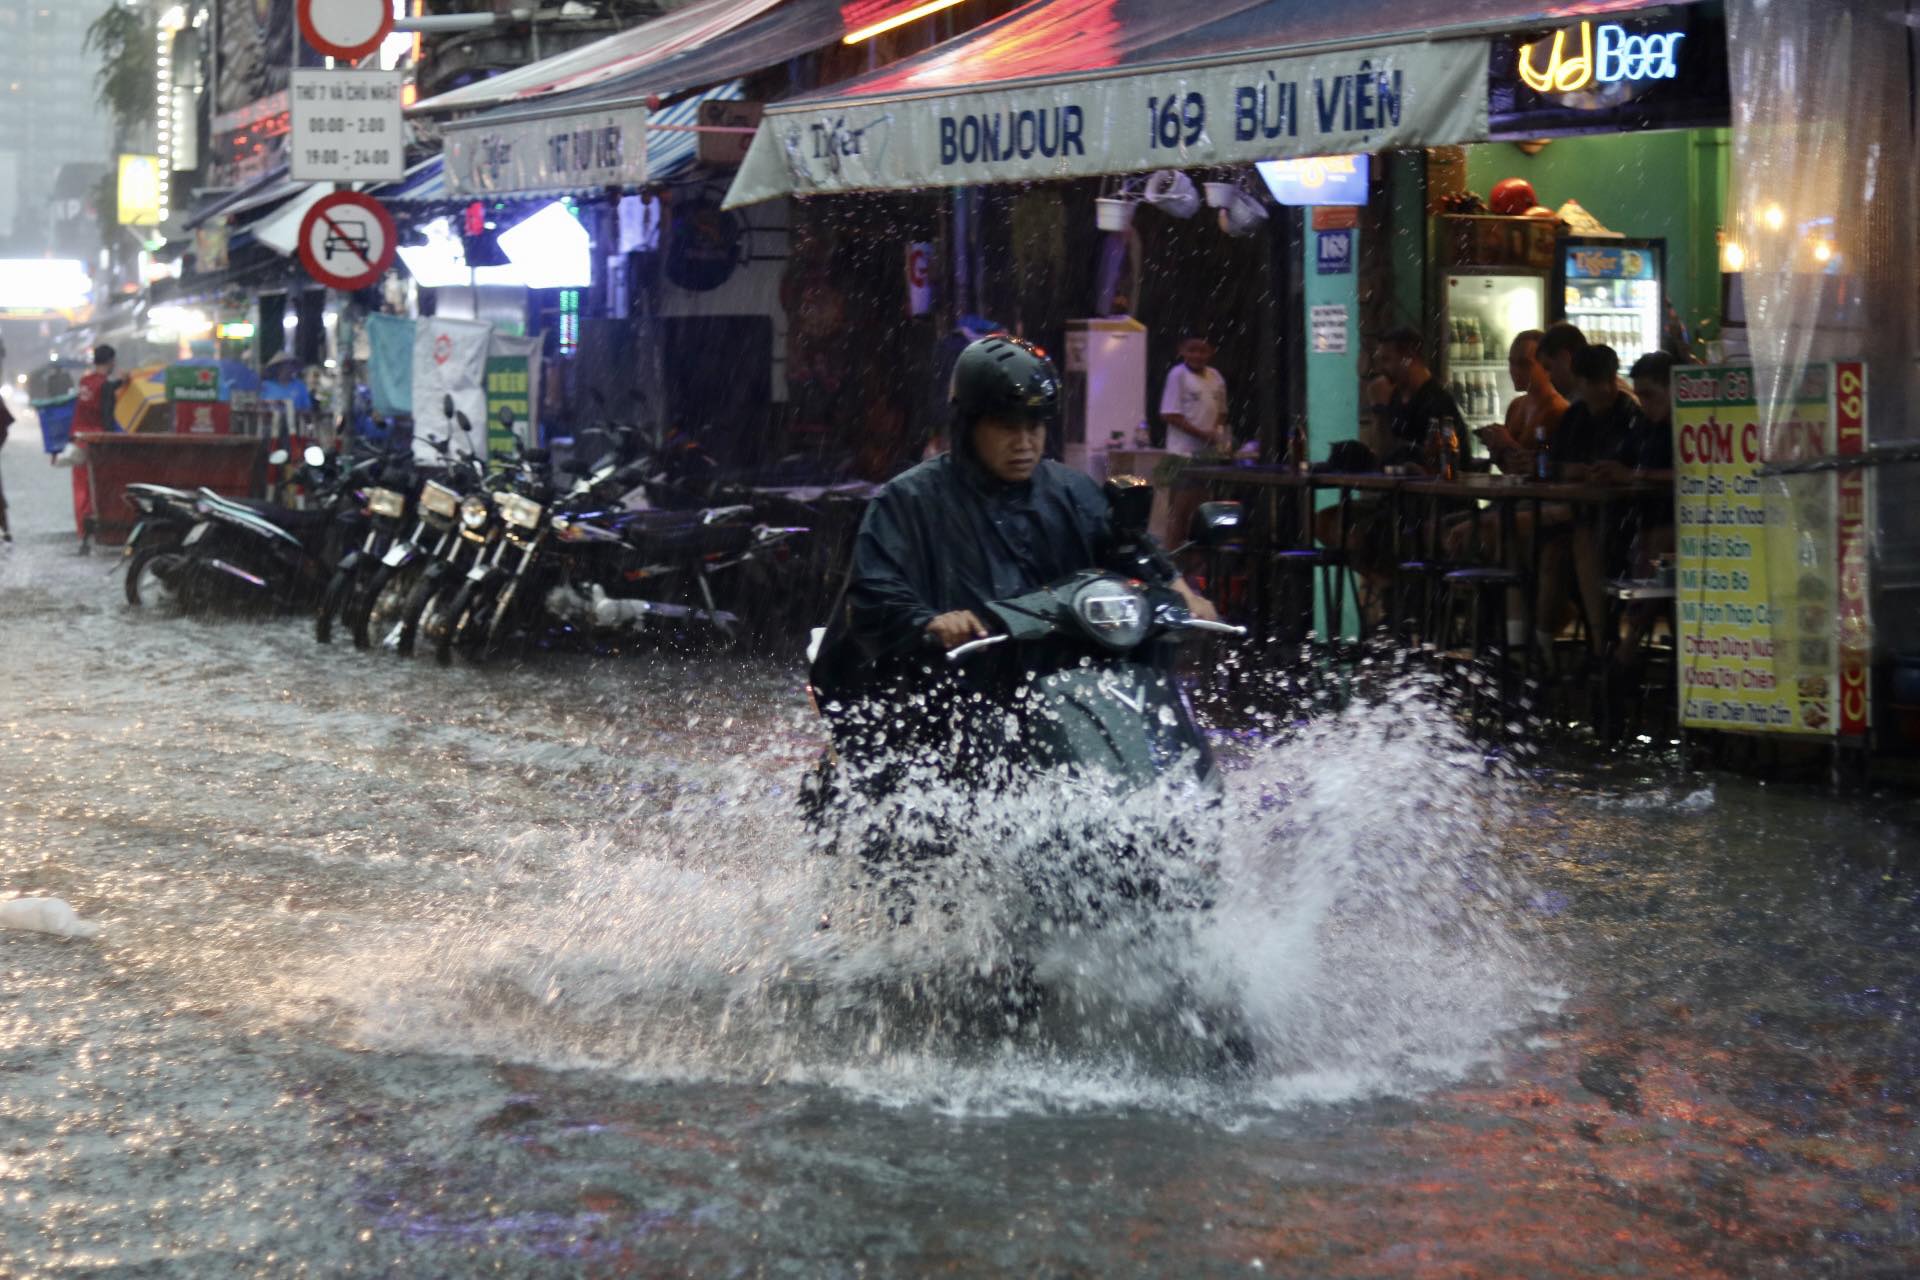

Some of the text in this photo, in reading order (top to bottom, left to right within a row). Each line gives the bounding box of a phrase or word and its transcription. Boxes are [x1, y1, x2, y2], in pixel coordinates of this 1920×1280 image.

[1595, 24, 1687, 82] Beer
[940, 104, 1086, 166] BONJOUR
[1147, 91, 1206, 149] 169
[1234, 70, 1298, 142] BÙI
[1314, 60, 1402, 143] VIỆN
[1679, 409, 1826, 464] CƠM CIÊN
[1840, 371, 1862, 440] 169
